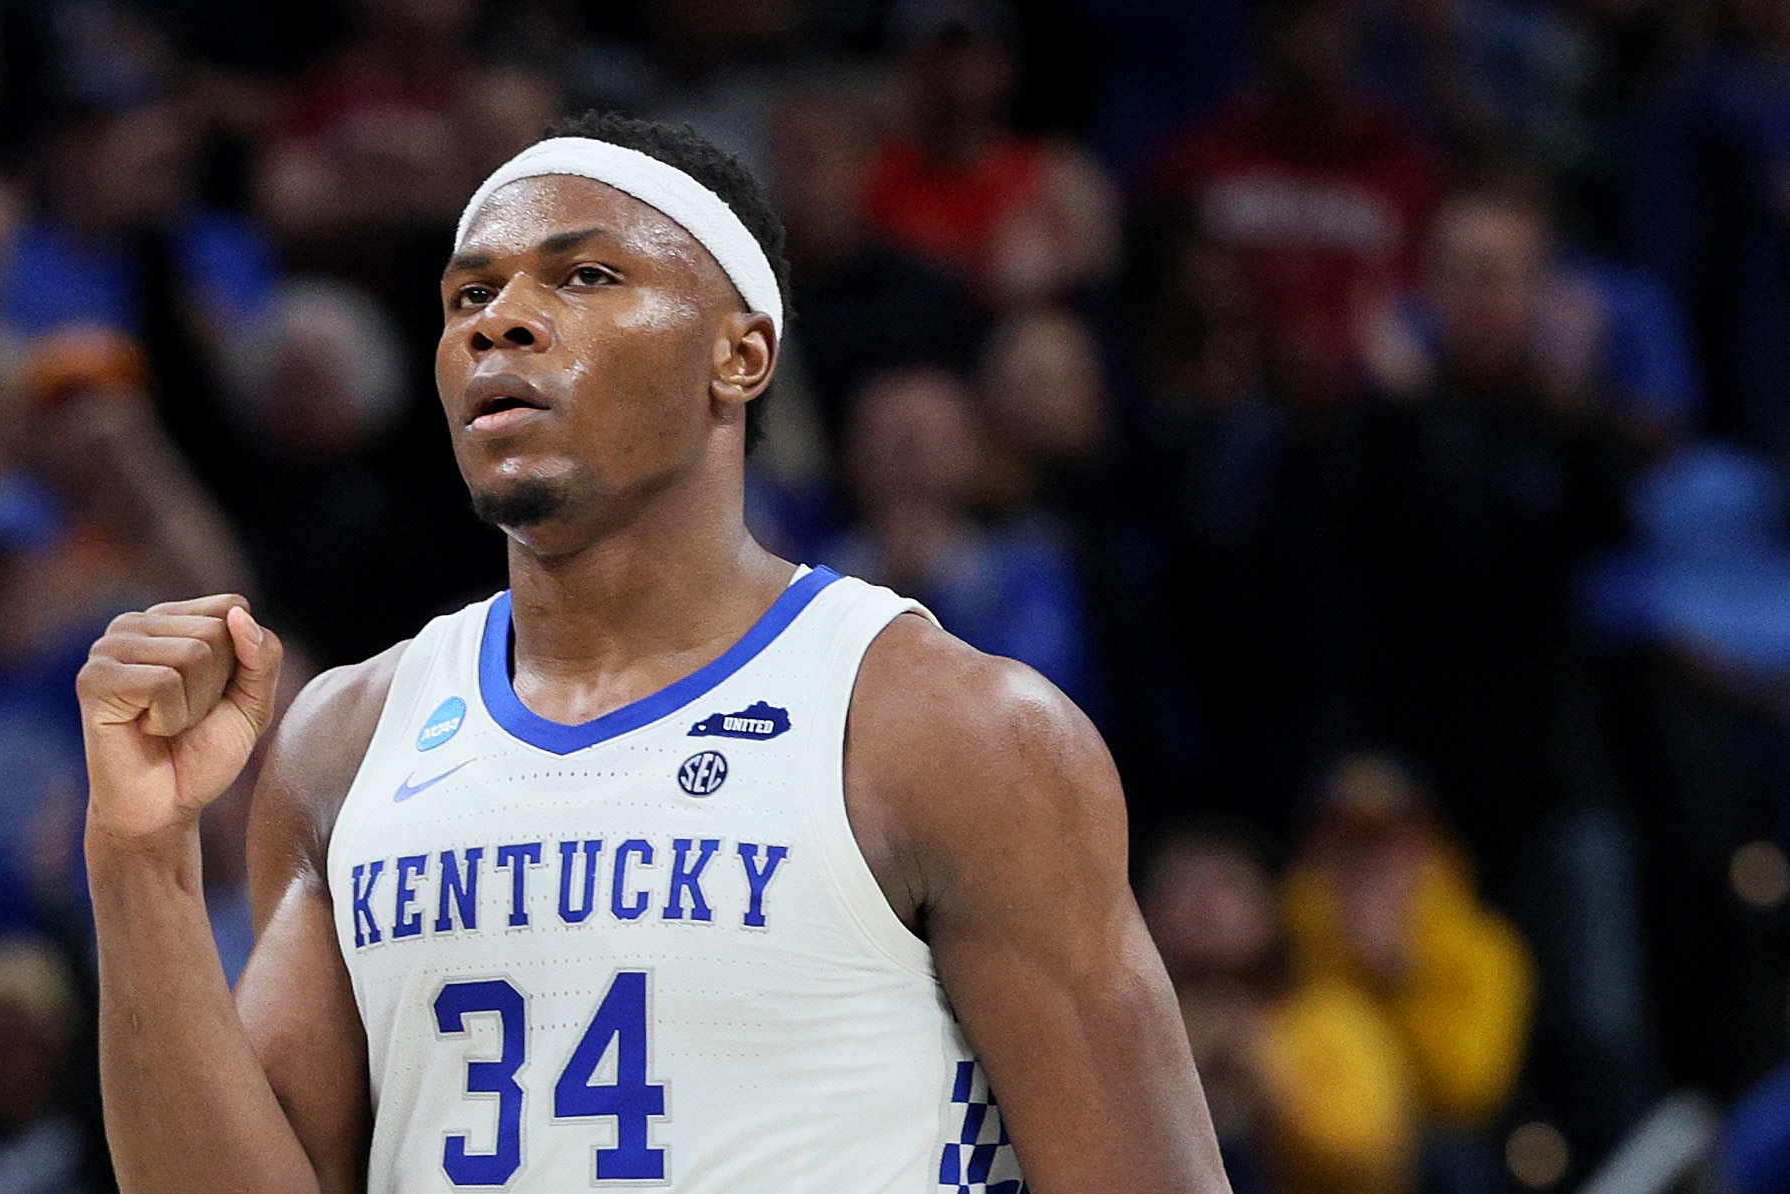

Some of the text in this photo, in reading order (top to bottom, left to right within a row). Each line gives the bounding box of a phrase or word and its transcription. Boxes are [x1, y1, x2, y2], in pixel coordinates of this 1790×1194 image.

[722, 716, 775, 735] UNITED
[679, 752, 726, 793] SEC
[349, 837, 791, 950] KENTUCKY
[430, 969, 669, 1190] 34
